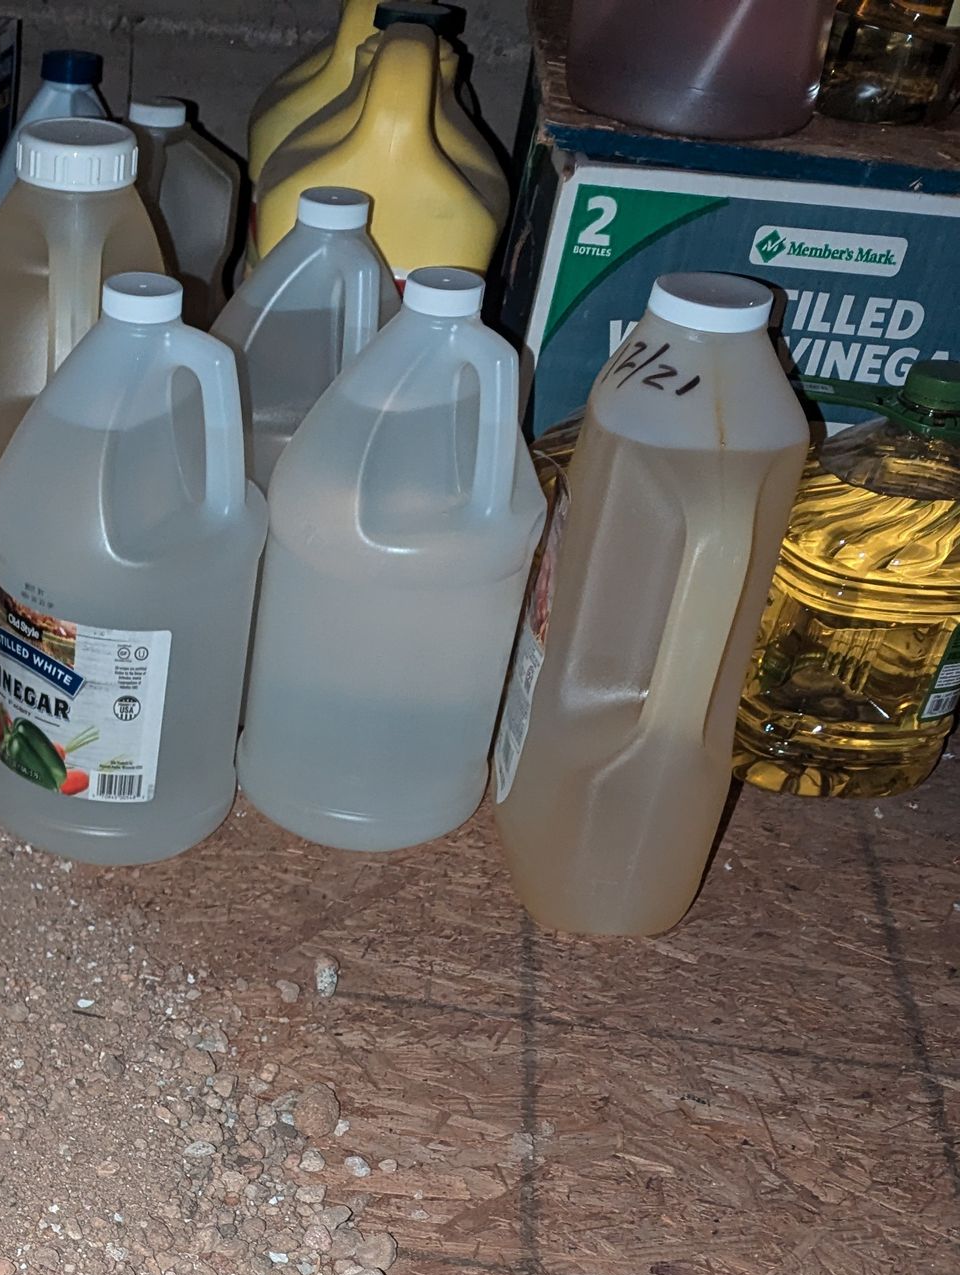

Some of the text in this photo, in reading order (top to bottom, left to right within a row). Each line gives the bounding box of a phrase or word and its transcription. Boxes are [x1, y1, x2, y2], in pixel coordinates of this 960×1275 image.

[578, 195, 618, 246] 2
[573, 245, 612, 257] BOTTLES
[786, 240, 854, 261] Member's
[783, 289, 925, 340] TILLED
[8, 613, 40, 640] Old Style
[32, 653, 73, 686] WHITE
[119, 706, 134, 714] USA
